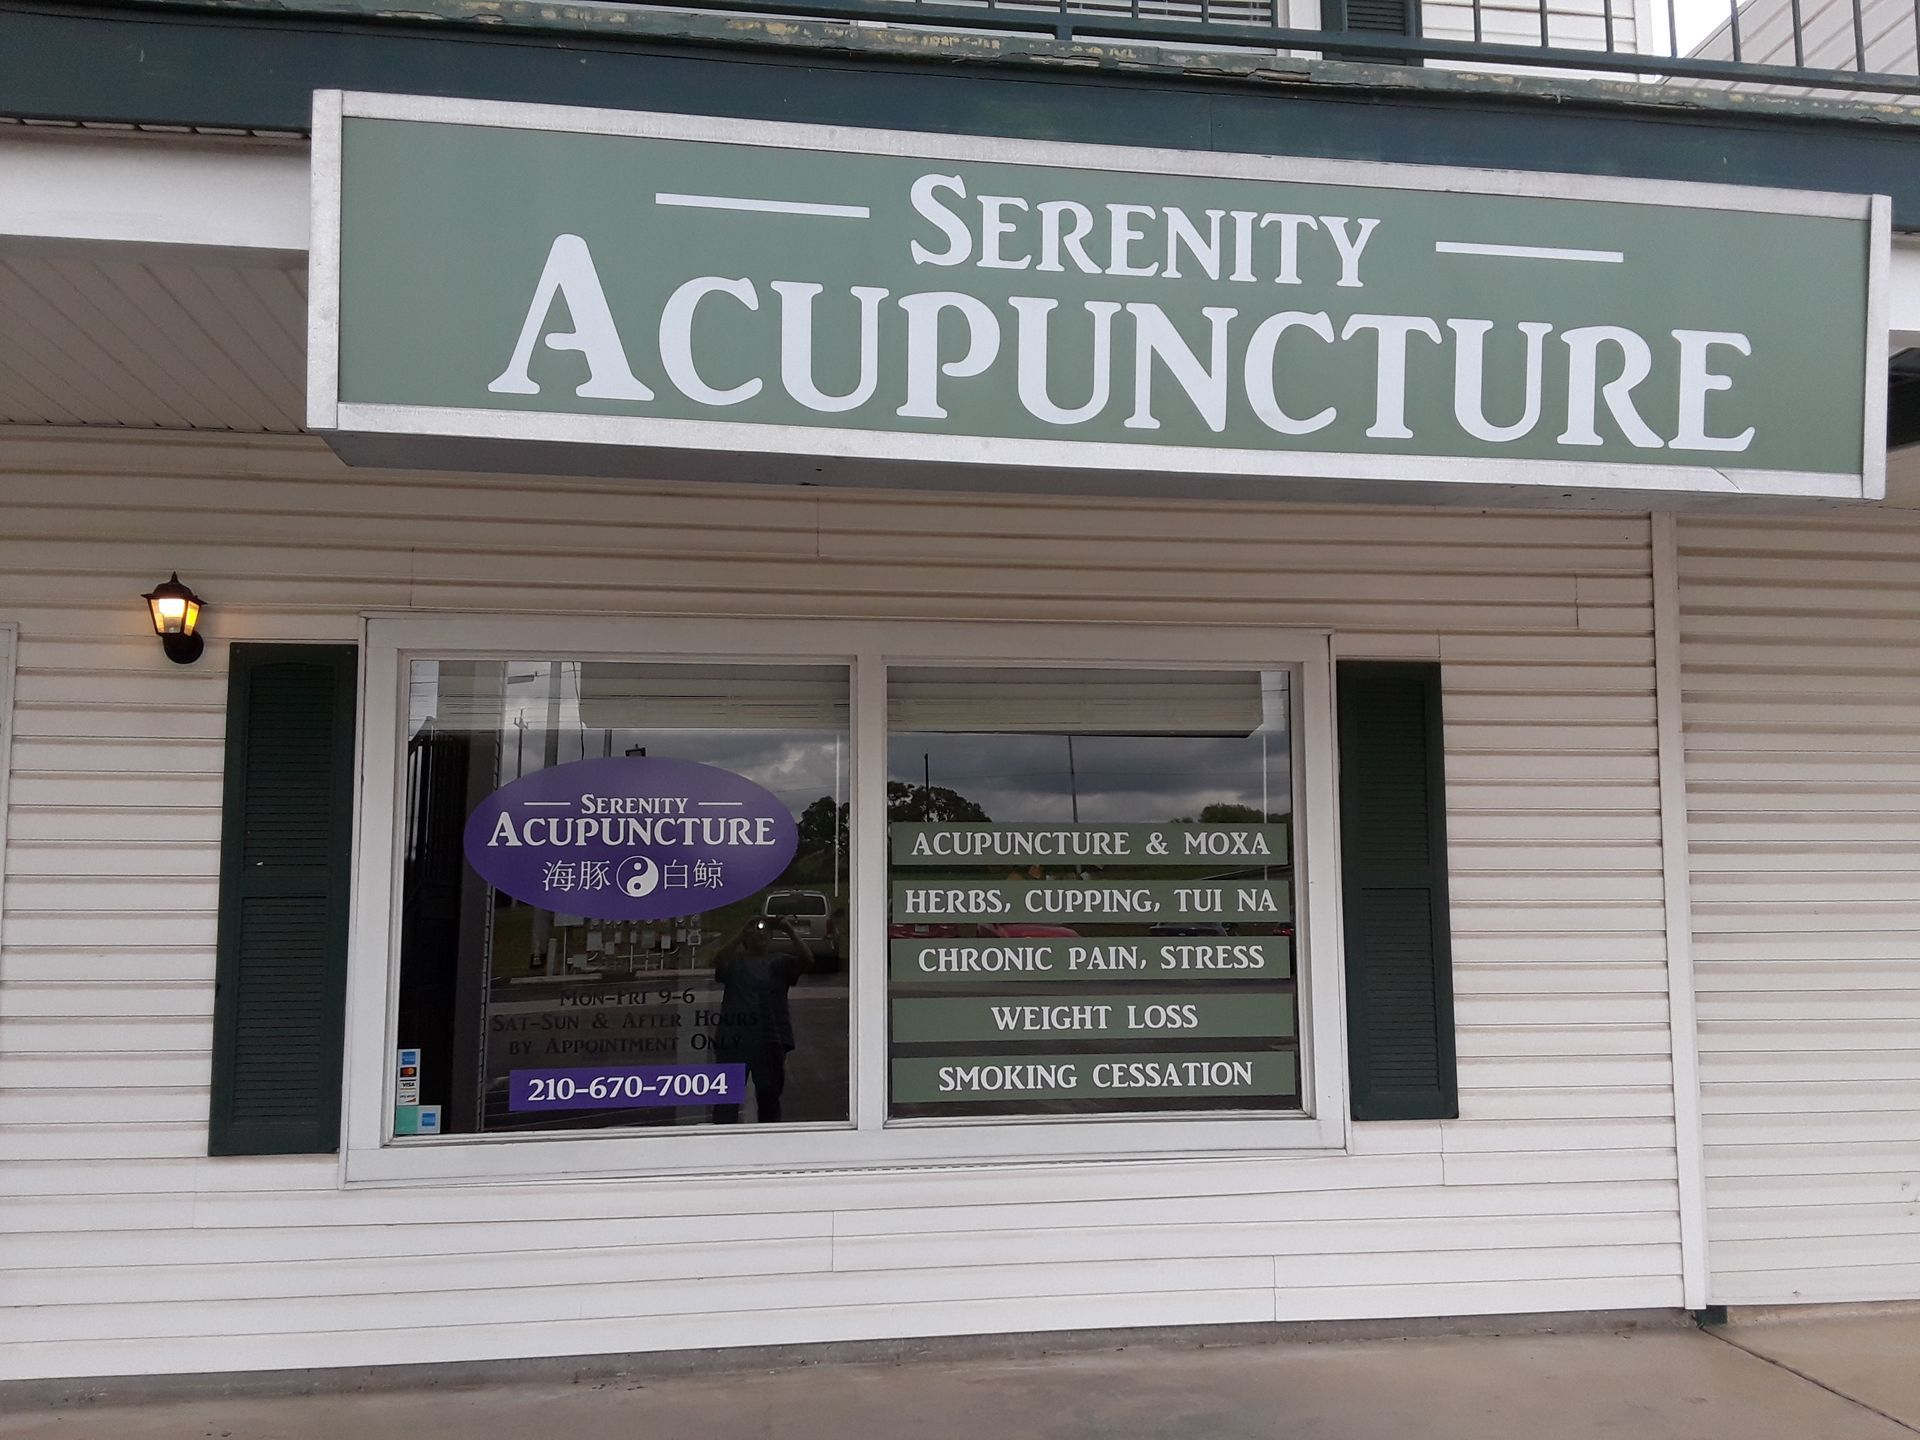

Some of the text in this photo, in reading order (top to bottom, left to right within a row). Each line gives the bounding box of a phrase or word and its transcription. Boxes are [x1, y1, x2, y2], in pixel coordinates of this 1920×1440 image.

[910, 174, 1380, 288] SERENITY
[488, 233, 1756, 454] ACUPUNCTURE
[582, 794, 688, 814] SERENITY
[487, 811, 776, 847] ACUPUNCTURE
[912, 832, 1270, 855] ACUPUNCTURE & MOXA
[543, 859, 723, 891] 海豚 白鲸
[906, 889, 1277, 913] HERBS, CUPPING, TUI NA
[919, 946, 1264, 971] CHRONIC PAIN, STRESS
[658, 987, 696, 1005] 9-6
[492, 1009, 758, 1032] SAT-SUN & AFTER HOURS
[991, 1005, 1198, 1030] WEIGHT LOSS
[509, 1033, 742, 1056] BY APPOINTMENT ONLY
[528, 1073, 728, 1100] 210-670-7004
[939, 1062, 1252, 1090] SMOKING CESSATION
